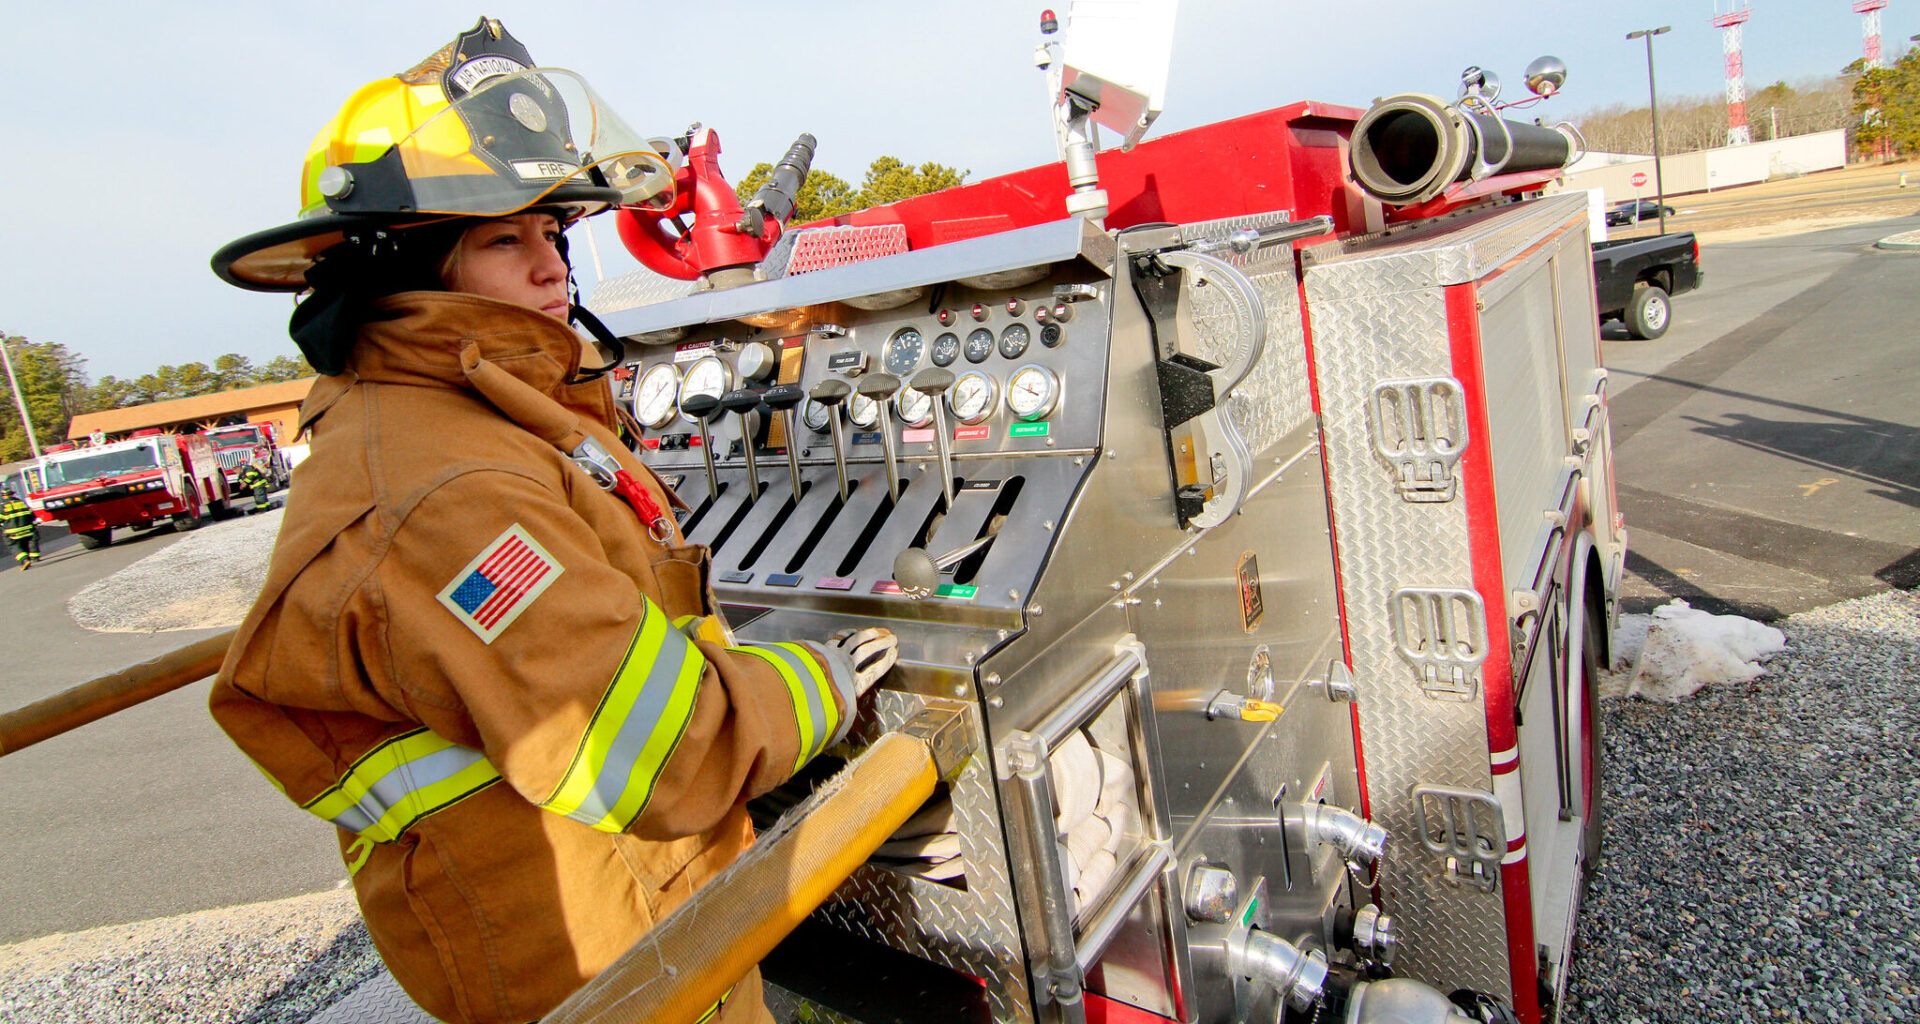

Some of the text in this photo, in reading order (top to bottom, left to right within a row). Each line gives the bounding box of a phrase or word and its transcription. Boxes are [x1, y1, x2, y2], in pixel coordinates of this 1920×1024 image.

[459, 69, 477, 85] AIR
[472, 59, 515, 75] NATIONAL
[537, 163, 567, 176] FIRE
[1631, 176, 1648, 184] STOP
